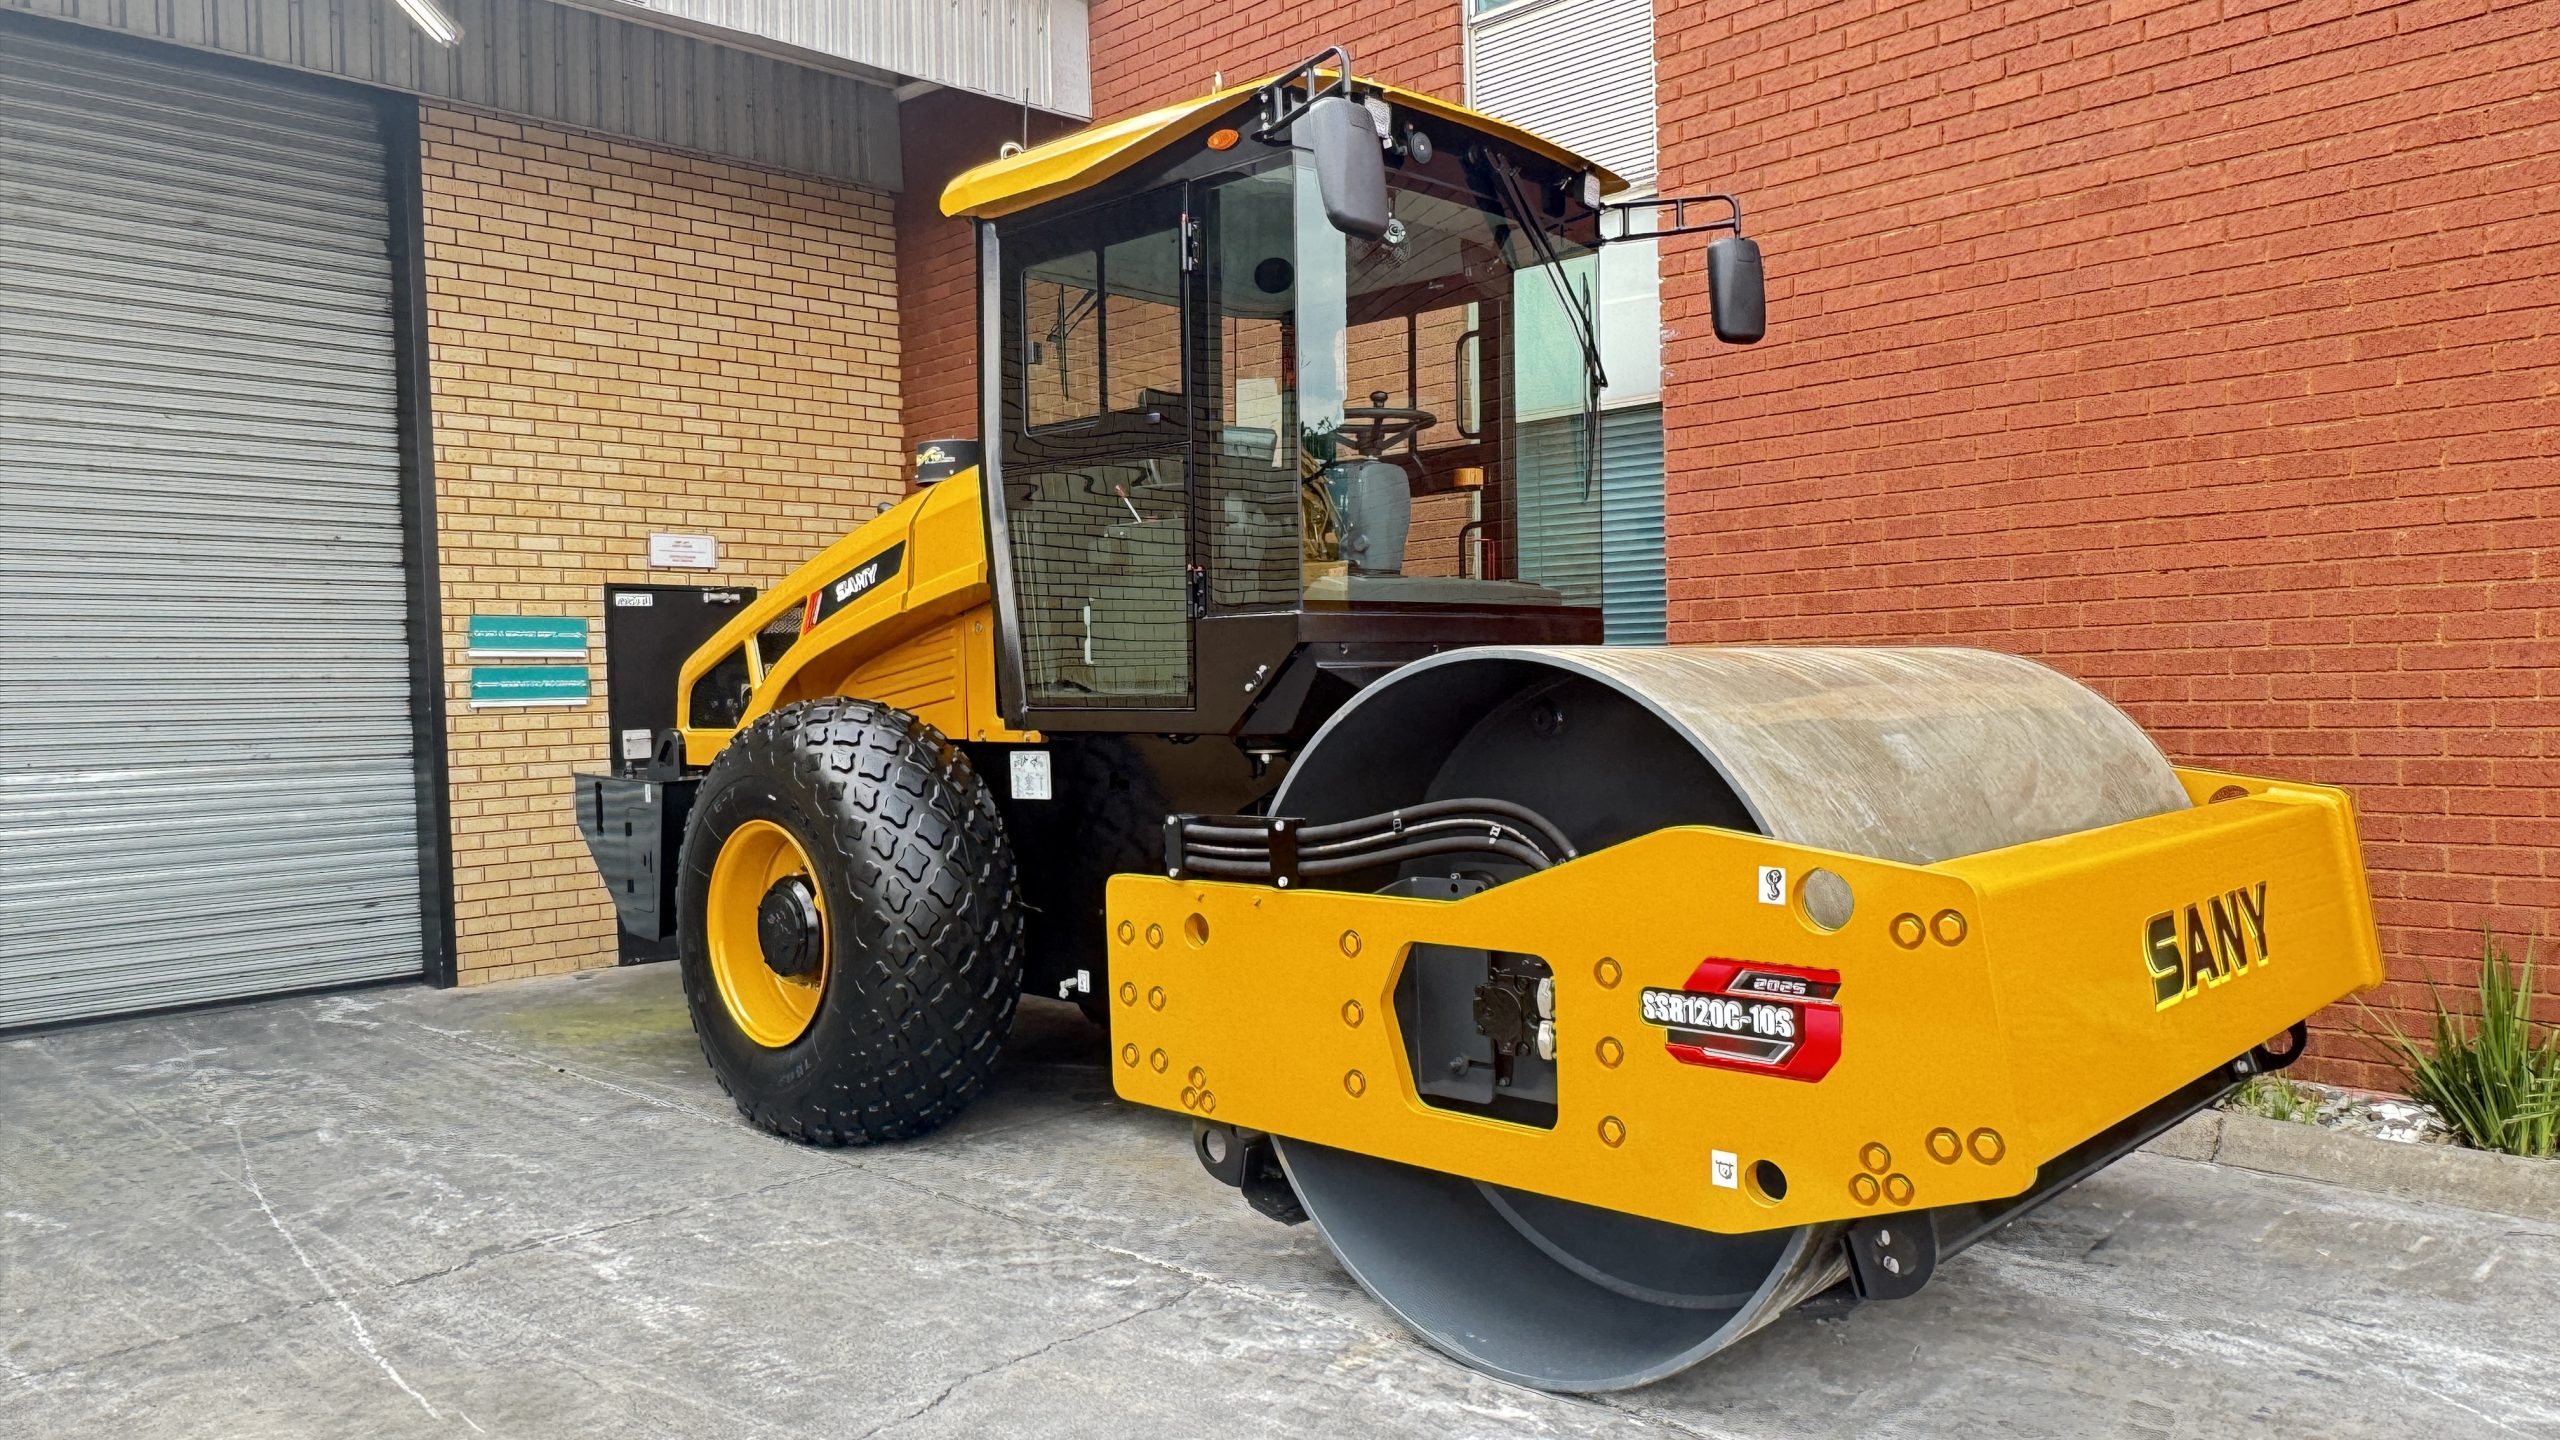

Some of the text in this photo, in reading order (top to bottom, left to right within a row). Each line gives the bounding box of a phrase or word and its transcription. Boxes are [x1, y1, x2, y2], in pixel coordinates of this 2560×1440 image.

[835, 563, 878, 602] SANY
[2142, 880, 2269, 1011] SANY
[1754, 977, 1806, 995] 2025
[1642, 990, 1795, 1038] SSR120C-10S
